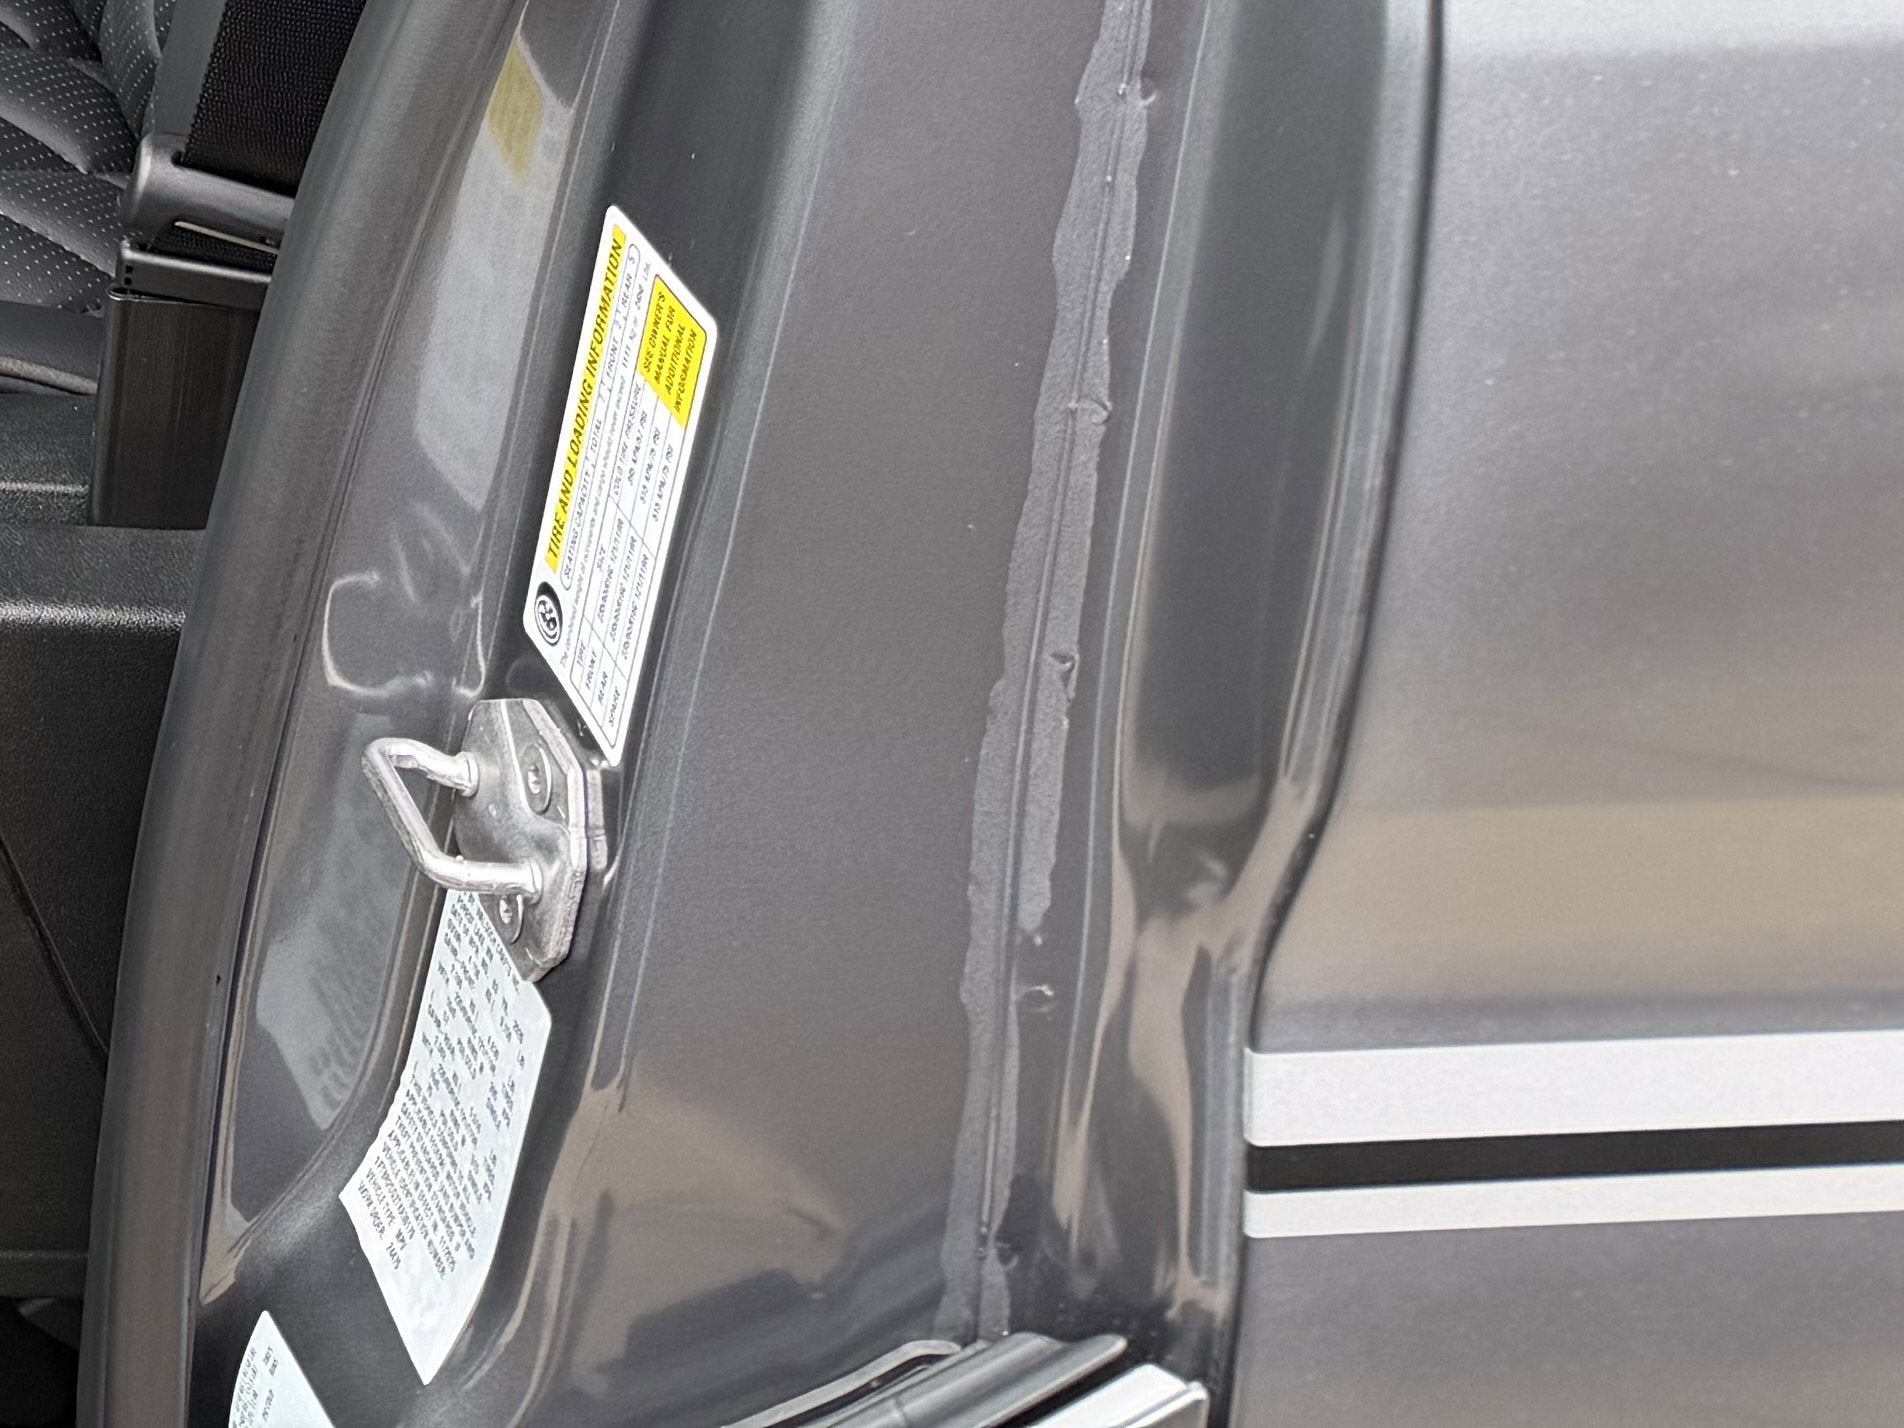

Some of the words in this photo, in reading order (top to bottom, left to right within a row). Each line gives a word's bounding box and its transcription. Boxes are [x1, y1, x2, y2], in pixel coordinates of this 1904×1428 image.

[648, 291, 665, 348] OWNER'S
[654, 334, 670, 384] MANUAL
[665, 306, 675, 332] FOR
[643, 348, 654, 372] SEE
[664, 324, 685, 395] ADDITIONAL
[673, 328, 697, 413] INFORMATION
[548, 512, 565, 558] TIRE
[558, 469, 573, 514] AND
[567, 378, 593, 468] LOADING
[586, 238, 622, 378] INFORMATION
[564, 528, 578, 579] SEATING
[574, 469, 590, 527] CAPACITY
[590, 419, 602, 453] TOTAL
[606, 336, 618, 378] FRONT
[621, 273, 632, 308] REAR
[624, 382, 641, 439] PRESSURE
[585, 649, 597, 690] FRONT
[598, 671, 608, 705] REAR
[608, 686, 620, 727] SPARE
[358, 1180, 374, 1208] WORK
[366, 1168, 386, 1205] VEHICLE
[382, 1141, 400, 1179] VEHICLE
[399, 1176, 429, 1240] IDENTIFICATION
